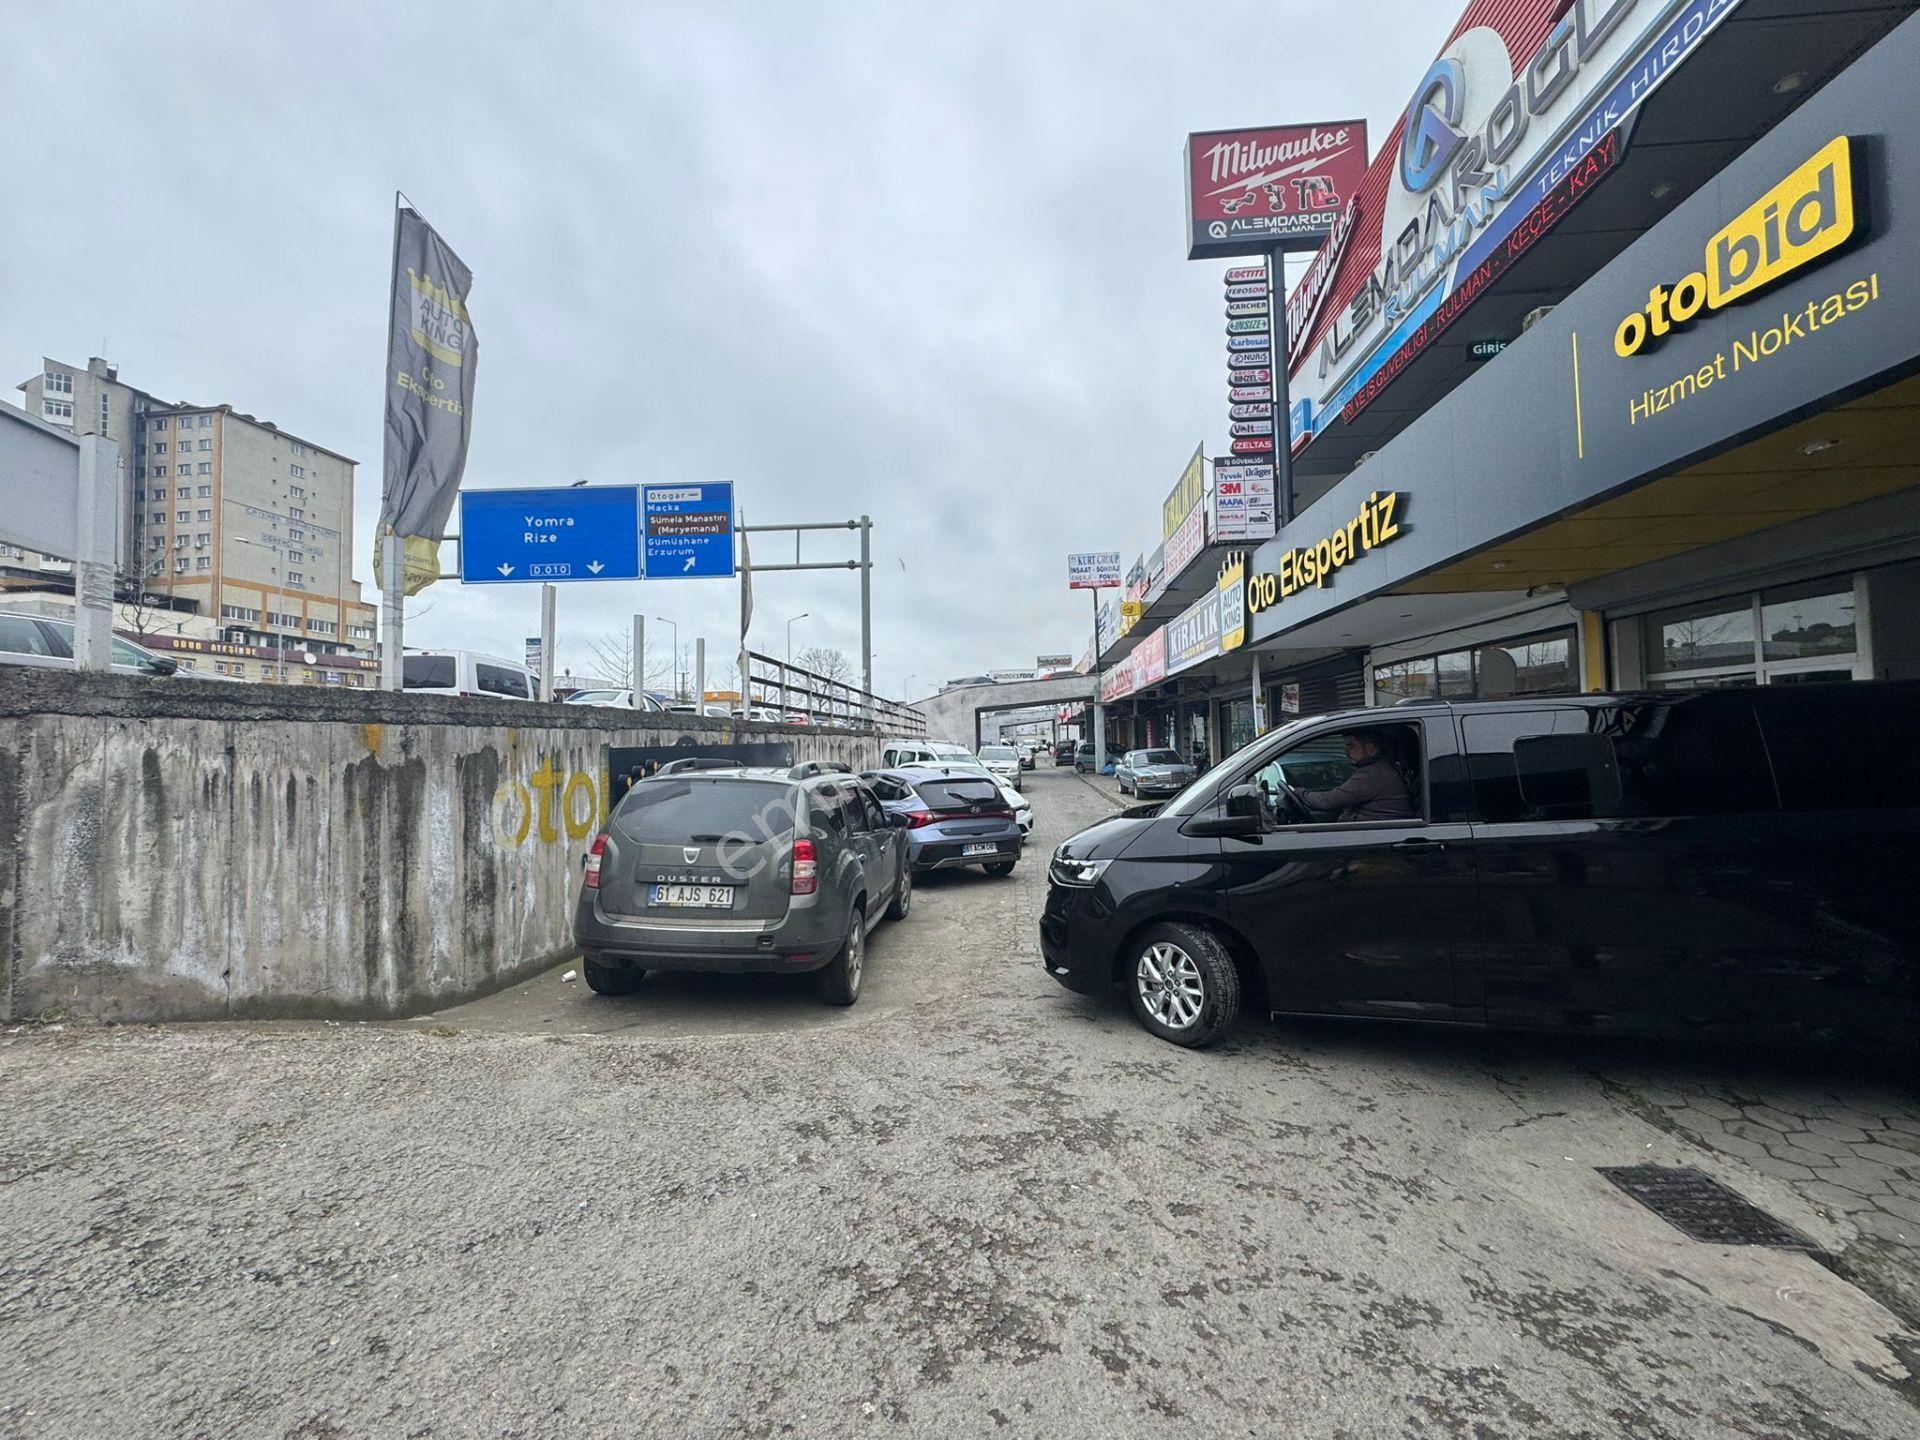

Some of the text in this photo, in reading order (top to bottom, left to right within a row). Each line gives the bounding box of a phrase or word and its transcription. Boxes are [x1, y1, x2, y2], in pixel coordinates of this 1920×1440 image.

[1538, 101, 1620, 193] TEKNİK
[1202, 127, 1349, 184] Milwaukee
[1270, 223, 1315, 234] RULMAN
[1614, 160, 1838, 358] otobid
[1228, 269, 1265, 279] LOCTITE
[420, 298, 464, 336] AUTO
[420, 315, 463, 350] KING
[1630, 272, 1880, 424] Hizmet Noktası
[422, 366, 445, 391] Oto
[1245, 468, 1272, 477] Dräger
[1220, 483, 1241, 494] 3M
[649, 492, 686, 500] Otogar
[1219, 498, 1244, 506] MAPA
[524, 516, 575, 528] Yomra
[650, 515, 727, 524] Sümela Manastırı
[657, 525, 719, 536] (Meryemana)
[524, 532, 558, 544] Rize
[648, 548, 695, 556] Erzurum
[1248, 573, 1276, 614] Oto
[1280, 491, 1399, 599] Ekspertiz
[1222, 584, 1242, 610] AUTO
[1223, 607, 1242, 631] KING
[657, 874, 721, 883] DUSTER
[656, 886, 731, 903] 61 AJS 621
